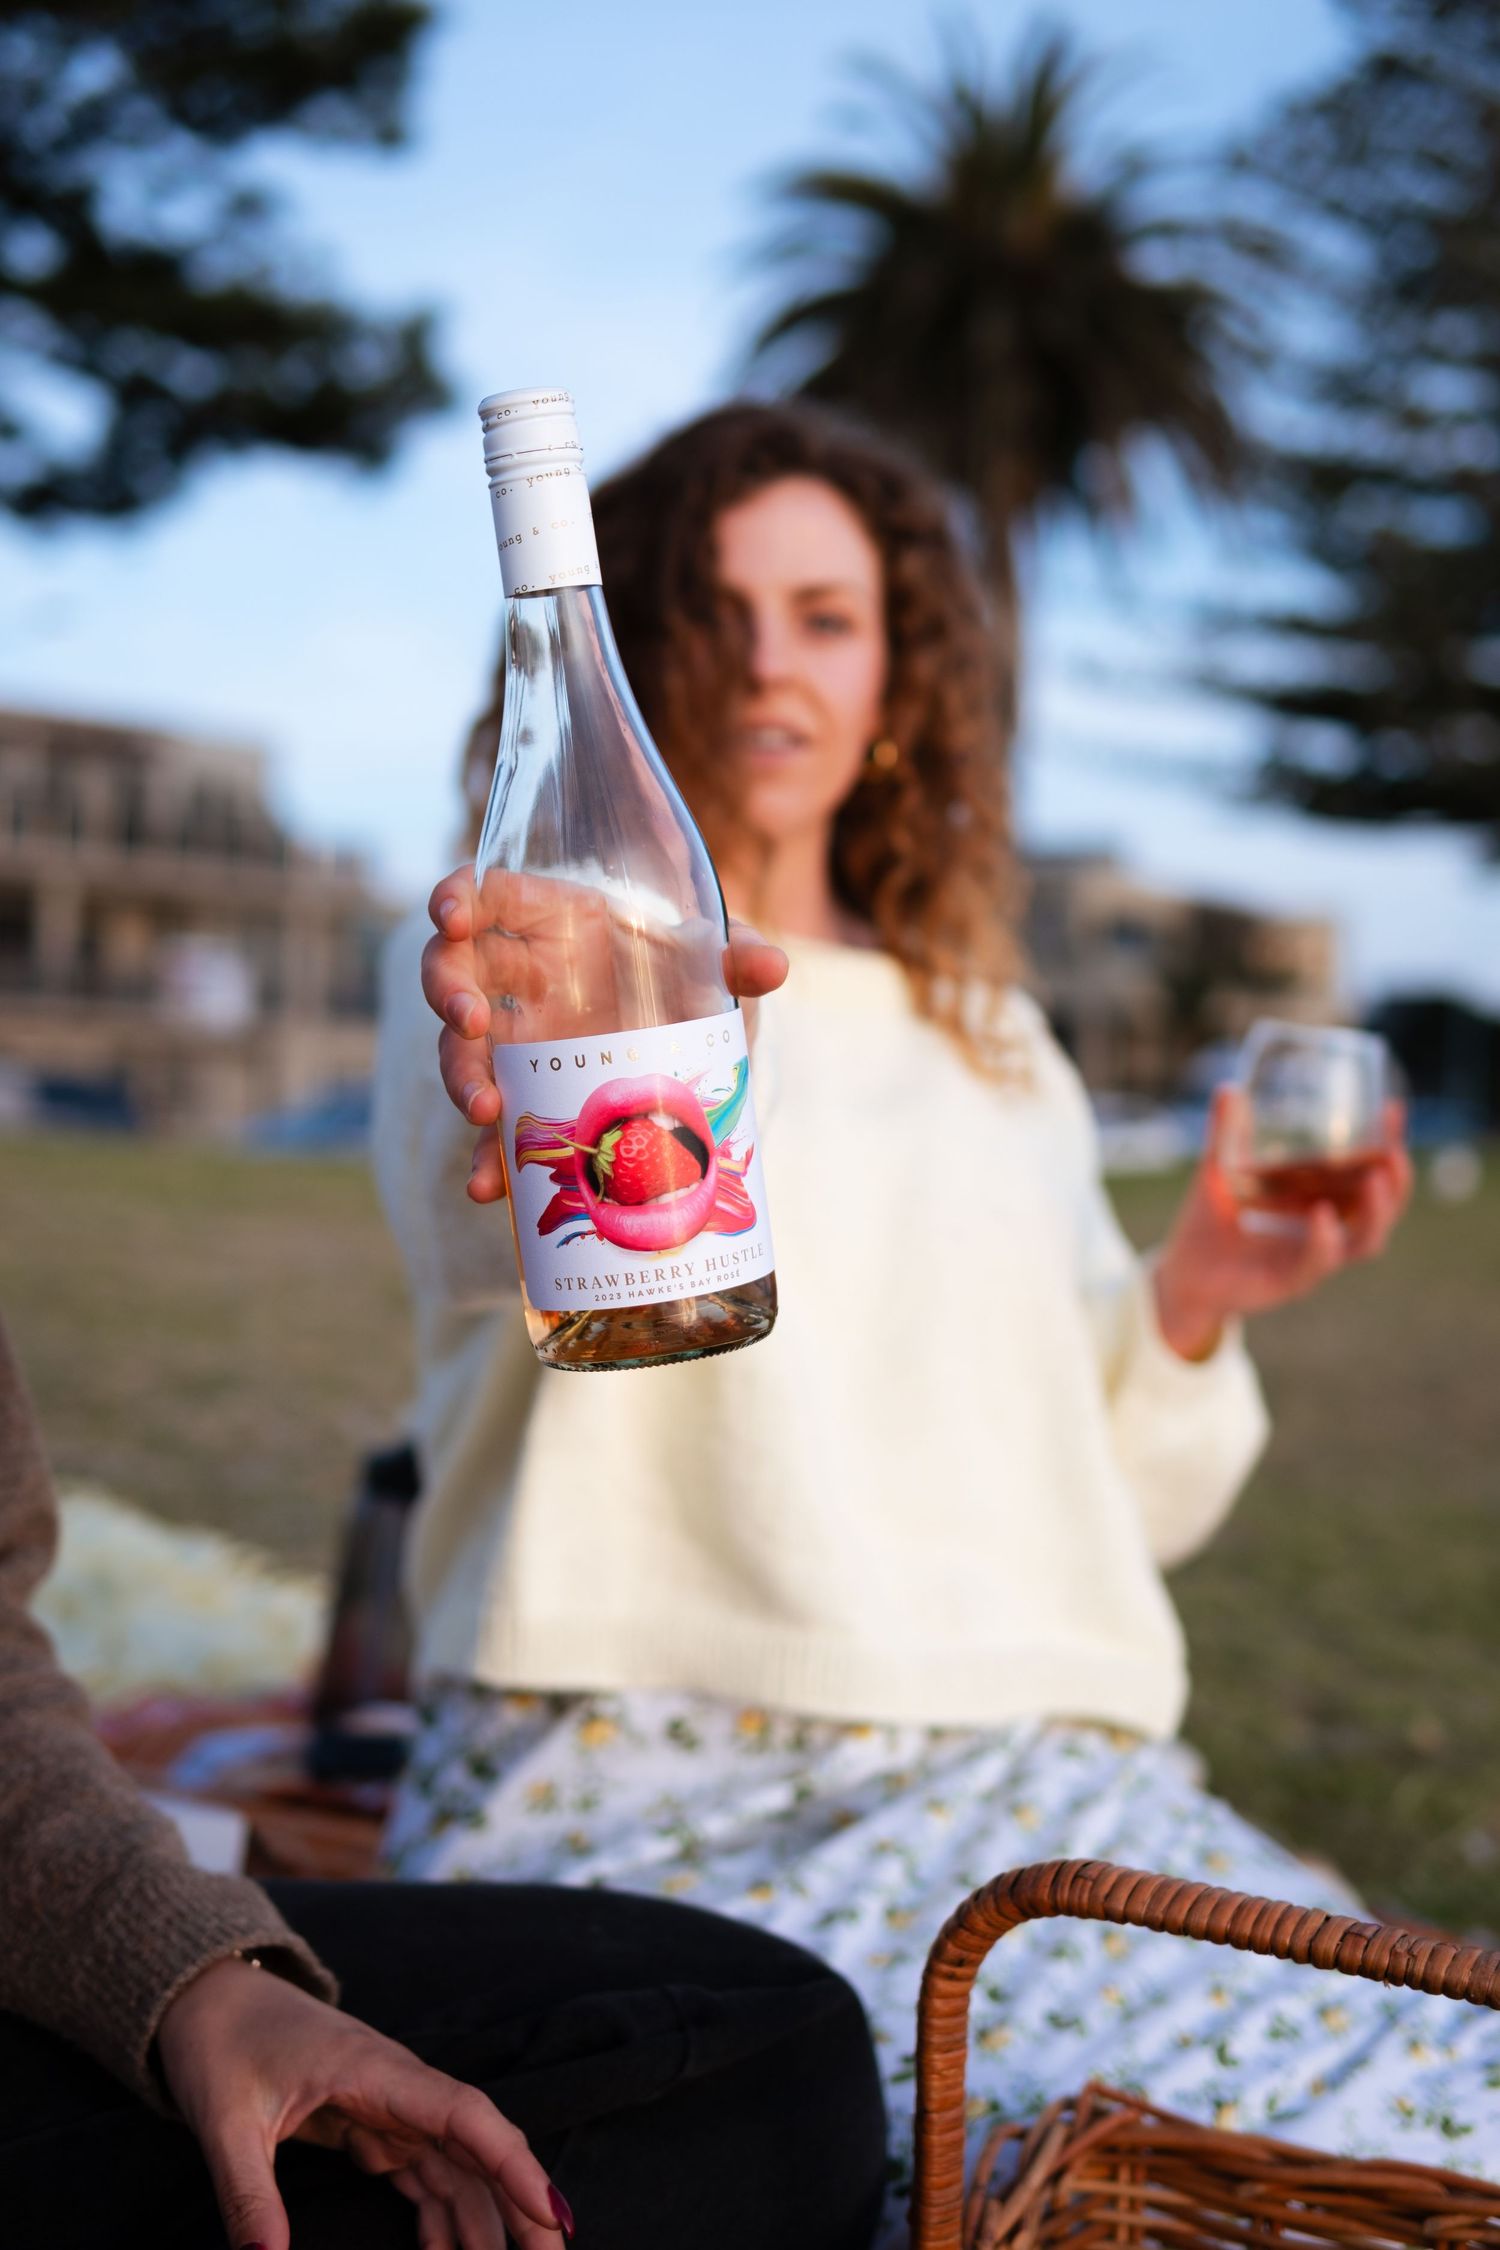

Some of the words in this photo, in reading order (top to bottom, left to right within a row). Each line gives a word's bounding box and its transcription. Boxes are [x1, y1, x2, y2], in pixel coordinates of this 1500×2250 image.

[532, 392, 570, 409] young
[495, 487, 513, 499] co.
[526, 467, 570, 488] young
[532, 526, 540, 536] &
[548, 564, 590, 584] young
[529, 1047, 640, 1073] YOUNG
[705, 1030, 730, 1048] CO
[554, 1261, 696, 1291] STRAWBERRY
[704, 1242, 765, 1273] HUSTLE
[594, 1292, 622, 1302] 2023
[628, 1282, 685, 1299] HAWKE'S
[690, 1277, 712, 1288] BAY
